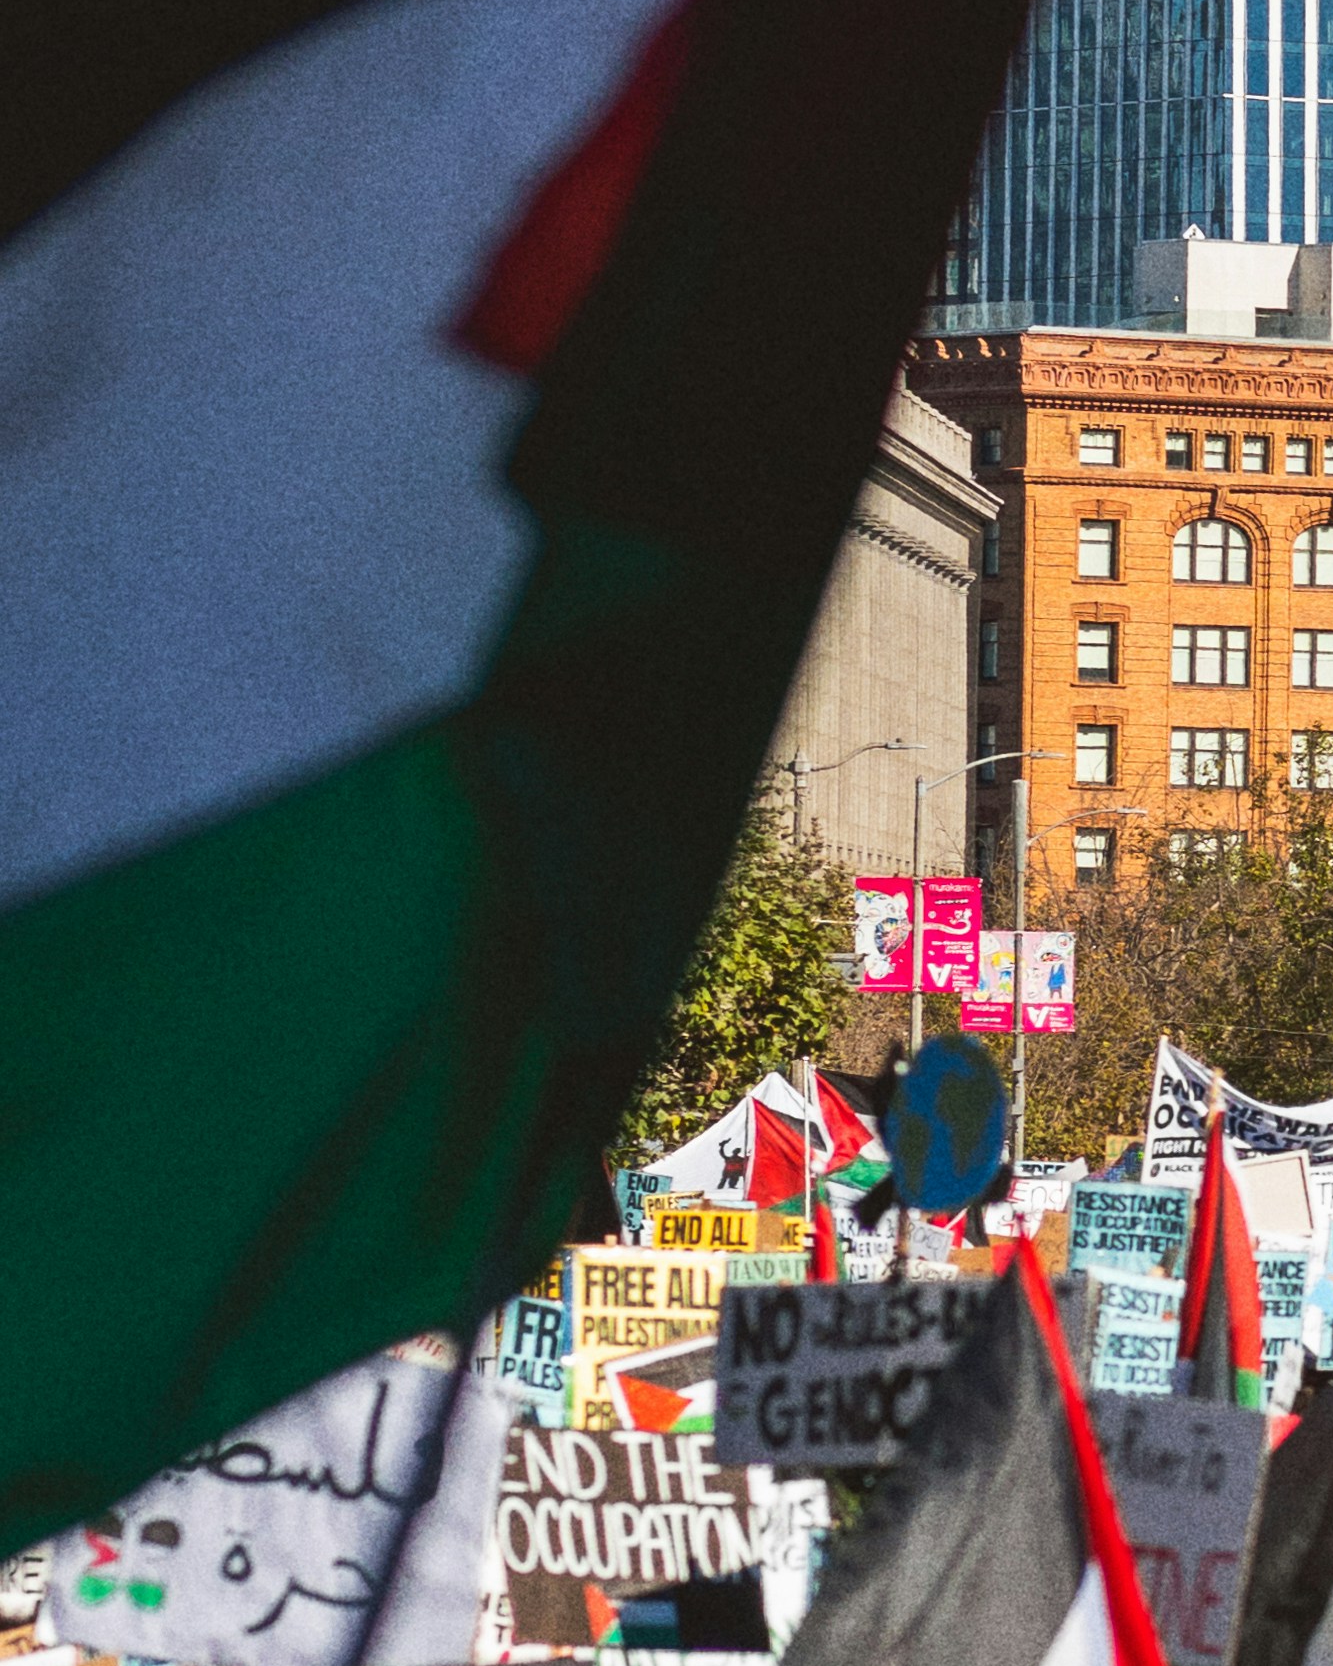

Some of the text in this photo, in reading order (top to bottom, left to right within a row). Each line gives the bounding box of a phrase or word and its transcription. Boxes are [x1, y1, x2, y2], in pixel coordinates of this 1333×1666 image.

[1152, 1139, 1206, 1156] FIGHT FO
[627, 1176, 659, 1192] END
[626, 1195, 645, 1208] AL
[1076, 1189, 1187, 1218] RESISTANCE
[660, 1215, 748, 1245] END ALL
[1075, 1213, 1184, 1235] TO OCCUPATION
[1074, 1232, 1088, 1249] IS
[584, 1264, 721, 1308] FREE ALL
[514, 1303, 562, 1359] FR
[733, 1292, 801, 1367] NO
[1105, 1334, 1172, 1361] RESIST
[503, 1357, 563, 1392] PALES
[500, 1427, 735, 1506] END THE
[497, 1497, 763, 1581] OCCUPATION
